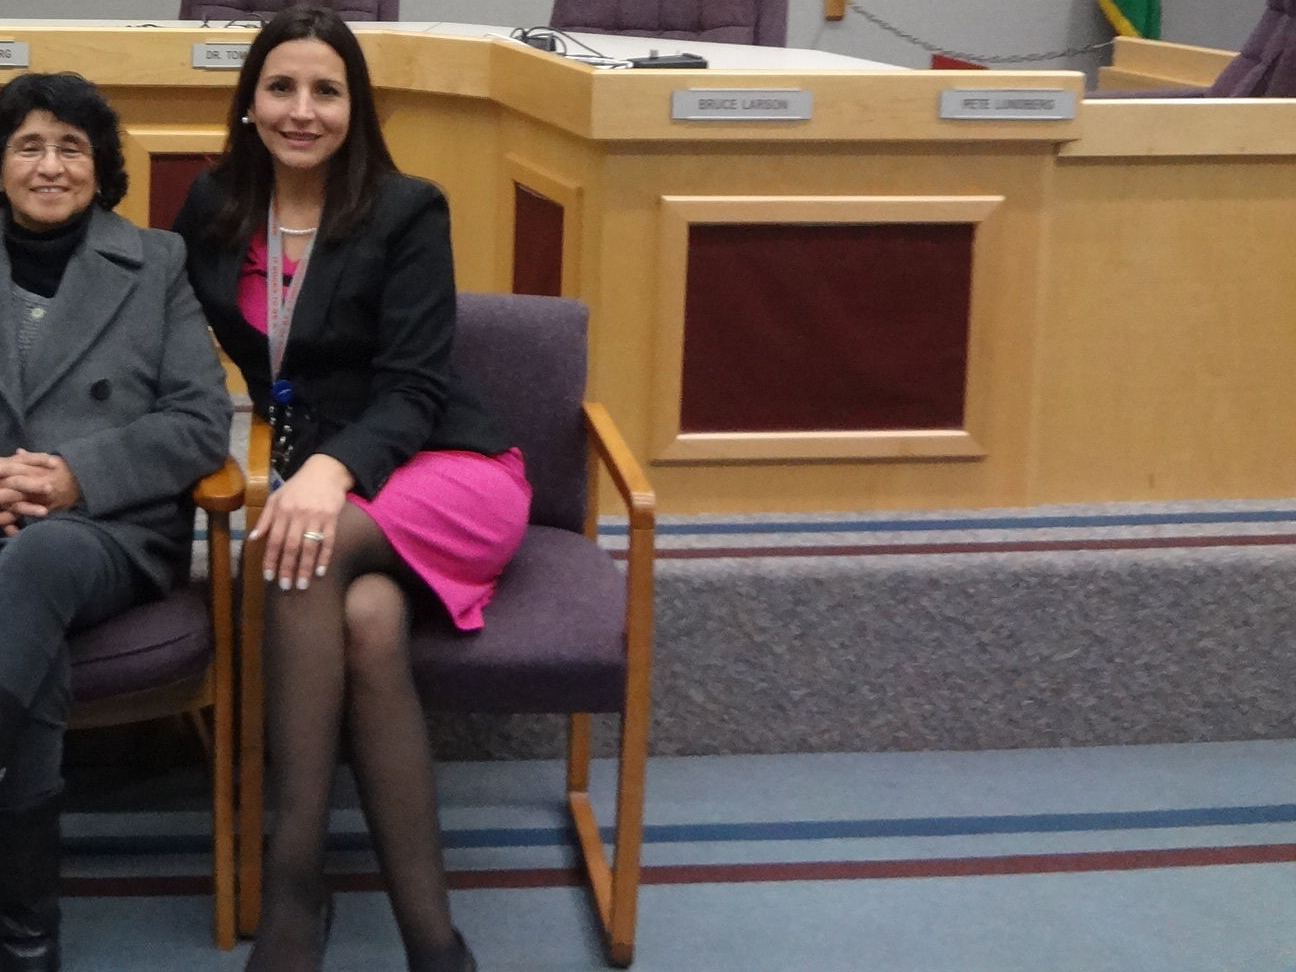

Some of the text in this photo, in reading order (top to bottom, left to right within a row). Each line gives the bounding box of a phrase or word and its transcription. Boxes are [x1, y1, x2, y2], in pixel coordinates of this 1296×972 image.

[206, 50, 222, 60] DR.
[698, 98, 789, 111] BRUCE LARSON
[961, 98, 991, 110] PETE
